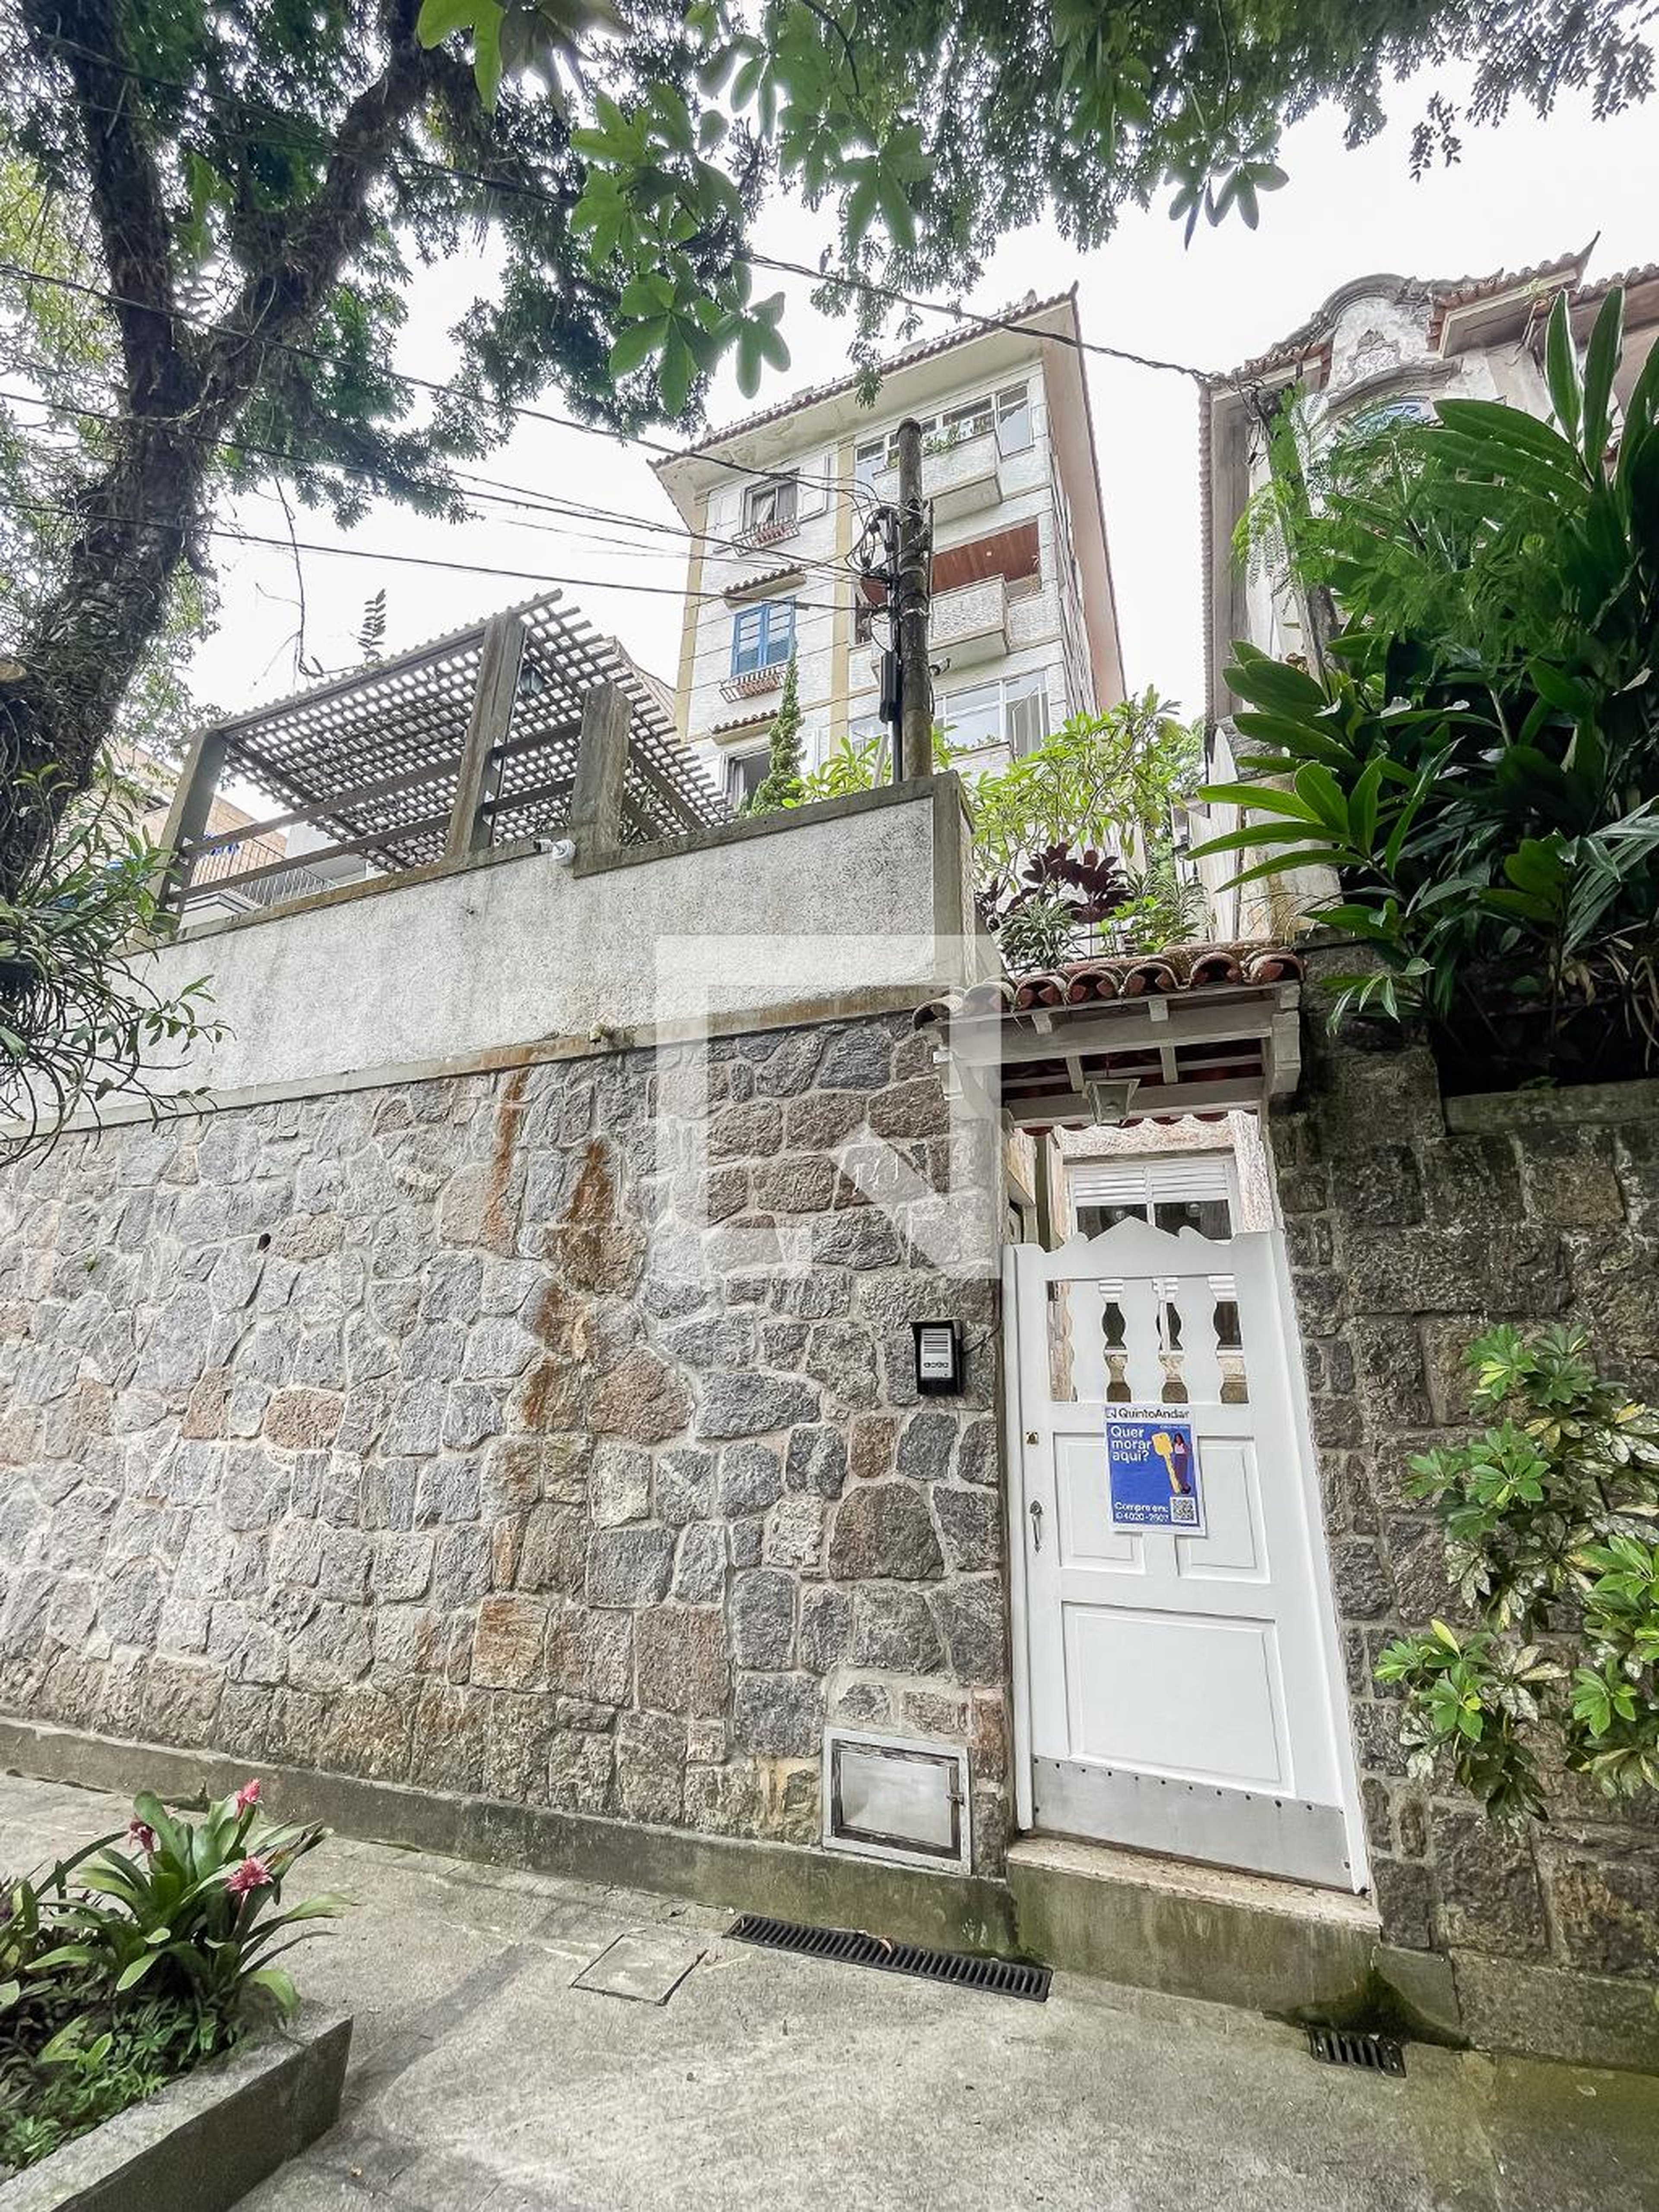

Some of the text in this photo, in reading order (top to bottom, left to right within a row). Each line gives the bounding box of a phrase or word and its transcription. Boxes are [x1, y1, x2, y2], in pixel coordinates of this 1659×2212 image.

[1119, 1408, 1189, 1419] QuintoAndar
[1111, 1426, 1144, 1438] Quer
[1112, 1439, 1151, 1450] morar
[1112, 1450, 1149, 1464] aqui?
